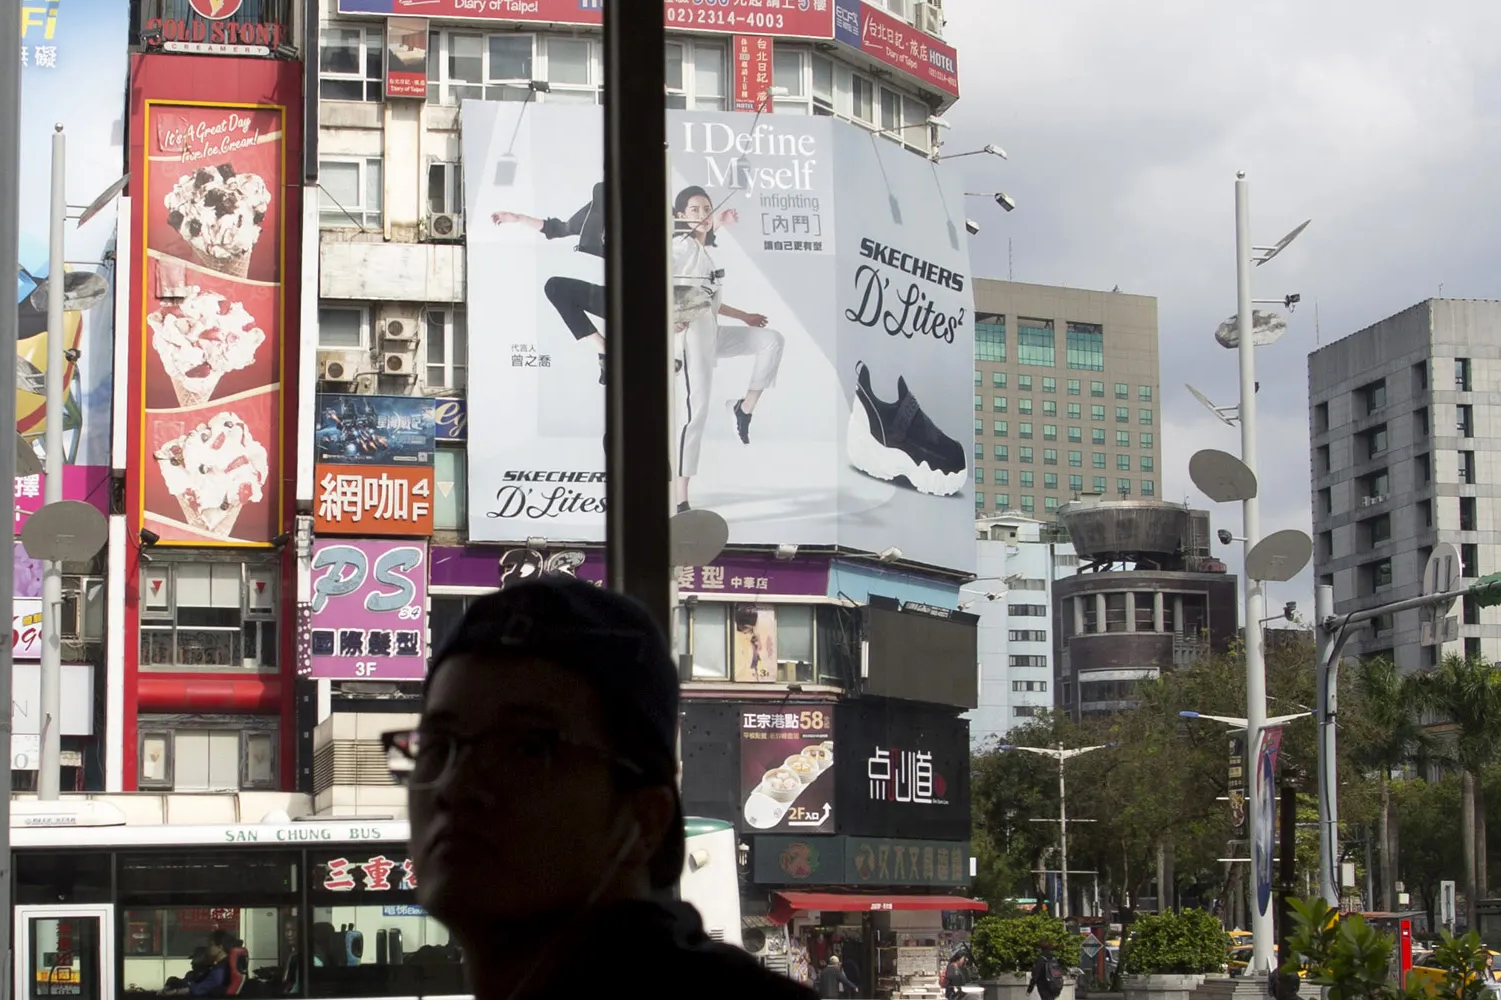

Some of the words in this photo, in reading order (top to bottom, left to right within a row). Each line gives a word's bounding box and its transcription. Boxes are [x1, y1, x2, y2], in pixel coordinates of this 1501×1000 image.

[146, 18, 206, 45] COLD
[211, 21, 288, 49] STONE
[171, 43, 263, 54] CREAMERY
[930, 48, 955, 74] HOTEL
[196, 119, 227, 143] Great
[229, 113, 252, 131] Day
[682, 121, 696, 153] I
[701, 122, 816, 157] Define
[203, 139, 219, 158] Ice
[220, 128, 260, 154] Cream!
[704, 156, 817, 198] Myself
[759, 193, 820, 212] infighting
[764, 240, 822, 251] 讓自己更有型
[859, 237, 964, 292] SKECHERS
[319, 473, 409, 522] 網咖
[486, 485, 608, 519] D'Lites
[311, 546, 424, 613] PS
[731, 577, 768, 590] 中華店
[356, 662, 376, 675] 3F
[743, 713, 799, 729] 正宗港點
[800, 711, 824, 730] 58
[788, 807, 805, 820] 2F
[805, 812, 819, 820] 入口
[226, 830, 257, 841] SAN
[277, 829, 330, 840] CHUNG
[350, 828, 381, 839] BUS
